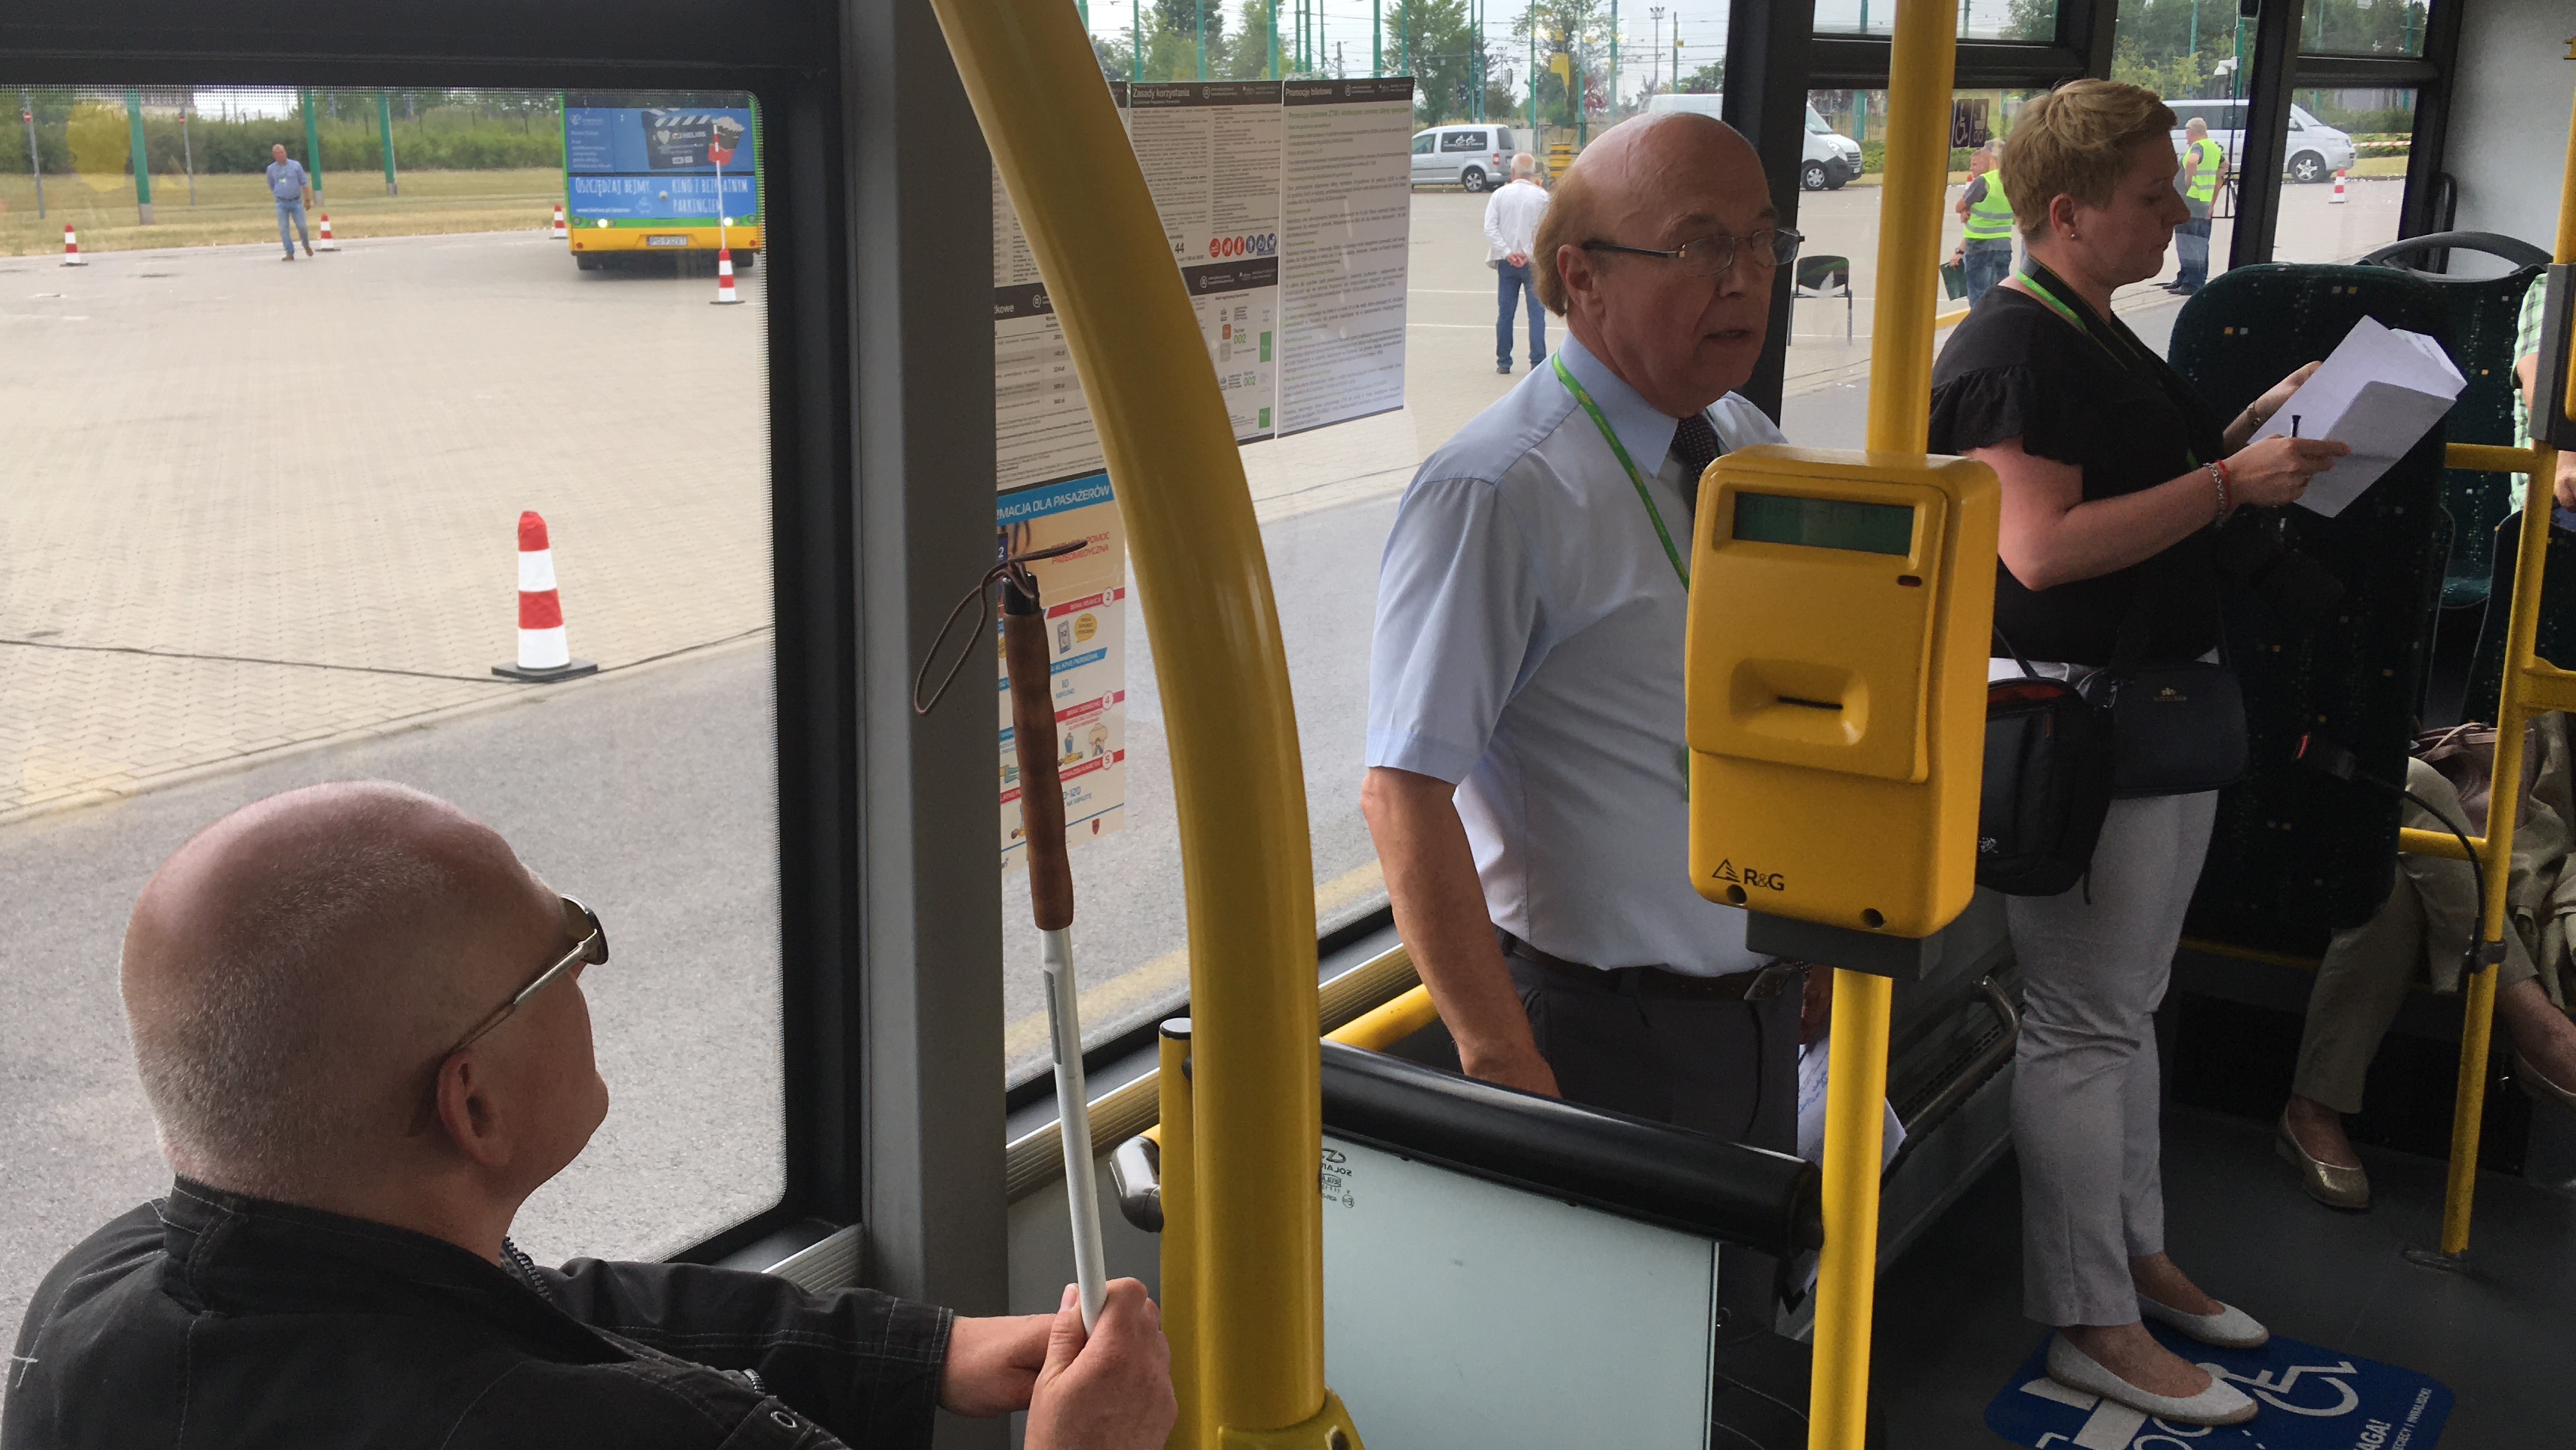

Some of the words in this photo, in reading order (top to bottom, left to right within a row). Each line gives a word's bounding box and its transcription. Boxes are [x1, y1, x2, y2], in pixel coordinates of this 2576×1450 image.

[1132, 88, 1156, 100] Zasady
[1157, 88, 1191, 99] korzystania
[701, 178, 748, 193] BEZPATNYM
[1033, 498, 1052, 512] DLA
[1053, 484, 1110, 507] PASAŻERÓW
[1105, 592, 1111, 601] 2
[1105, 696, 1110, 705] 4
[1105, 754, 1111, 764] 5
[1743, 868, 1785, 891] R&G
[2354, 1418, 2393, 1450] AGA!
